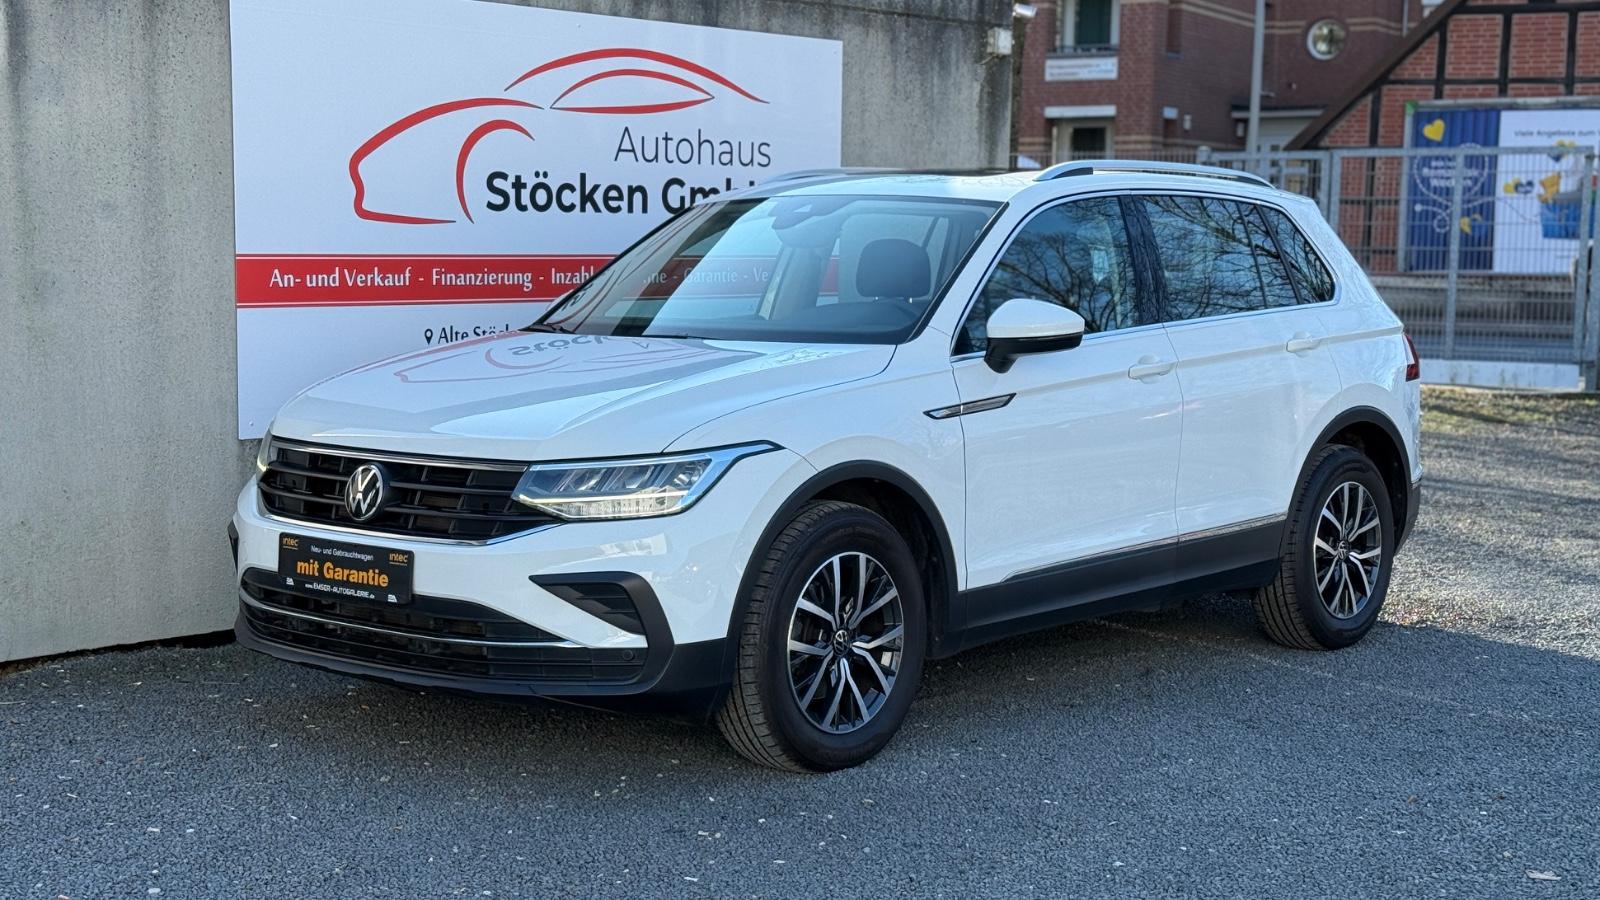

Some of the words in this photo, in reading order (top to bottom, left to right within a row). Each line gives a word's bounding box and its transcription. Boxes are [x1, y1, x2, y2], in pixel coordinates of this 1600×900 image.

[614, 126, 771, 167] Autohaus
[486, 170, 649, 214] Stöcken
[269, 268, 302, 288] An-
[306, 267, 339, 288] und
[344, 266, 411, 288] Verkauf
[432, 268, 532, 292] Finanzierung
[684, 267, 738, 283] Garantie
[438, 325, 469, 344] Alte
[296, 559, 319, 576] mit
[323, 561, 389, 587] Garantie
